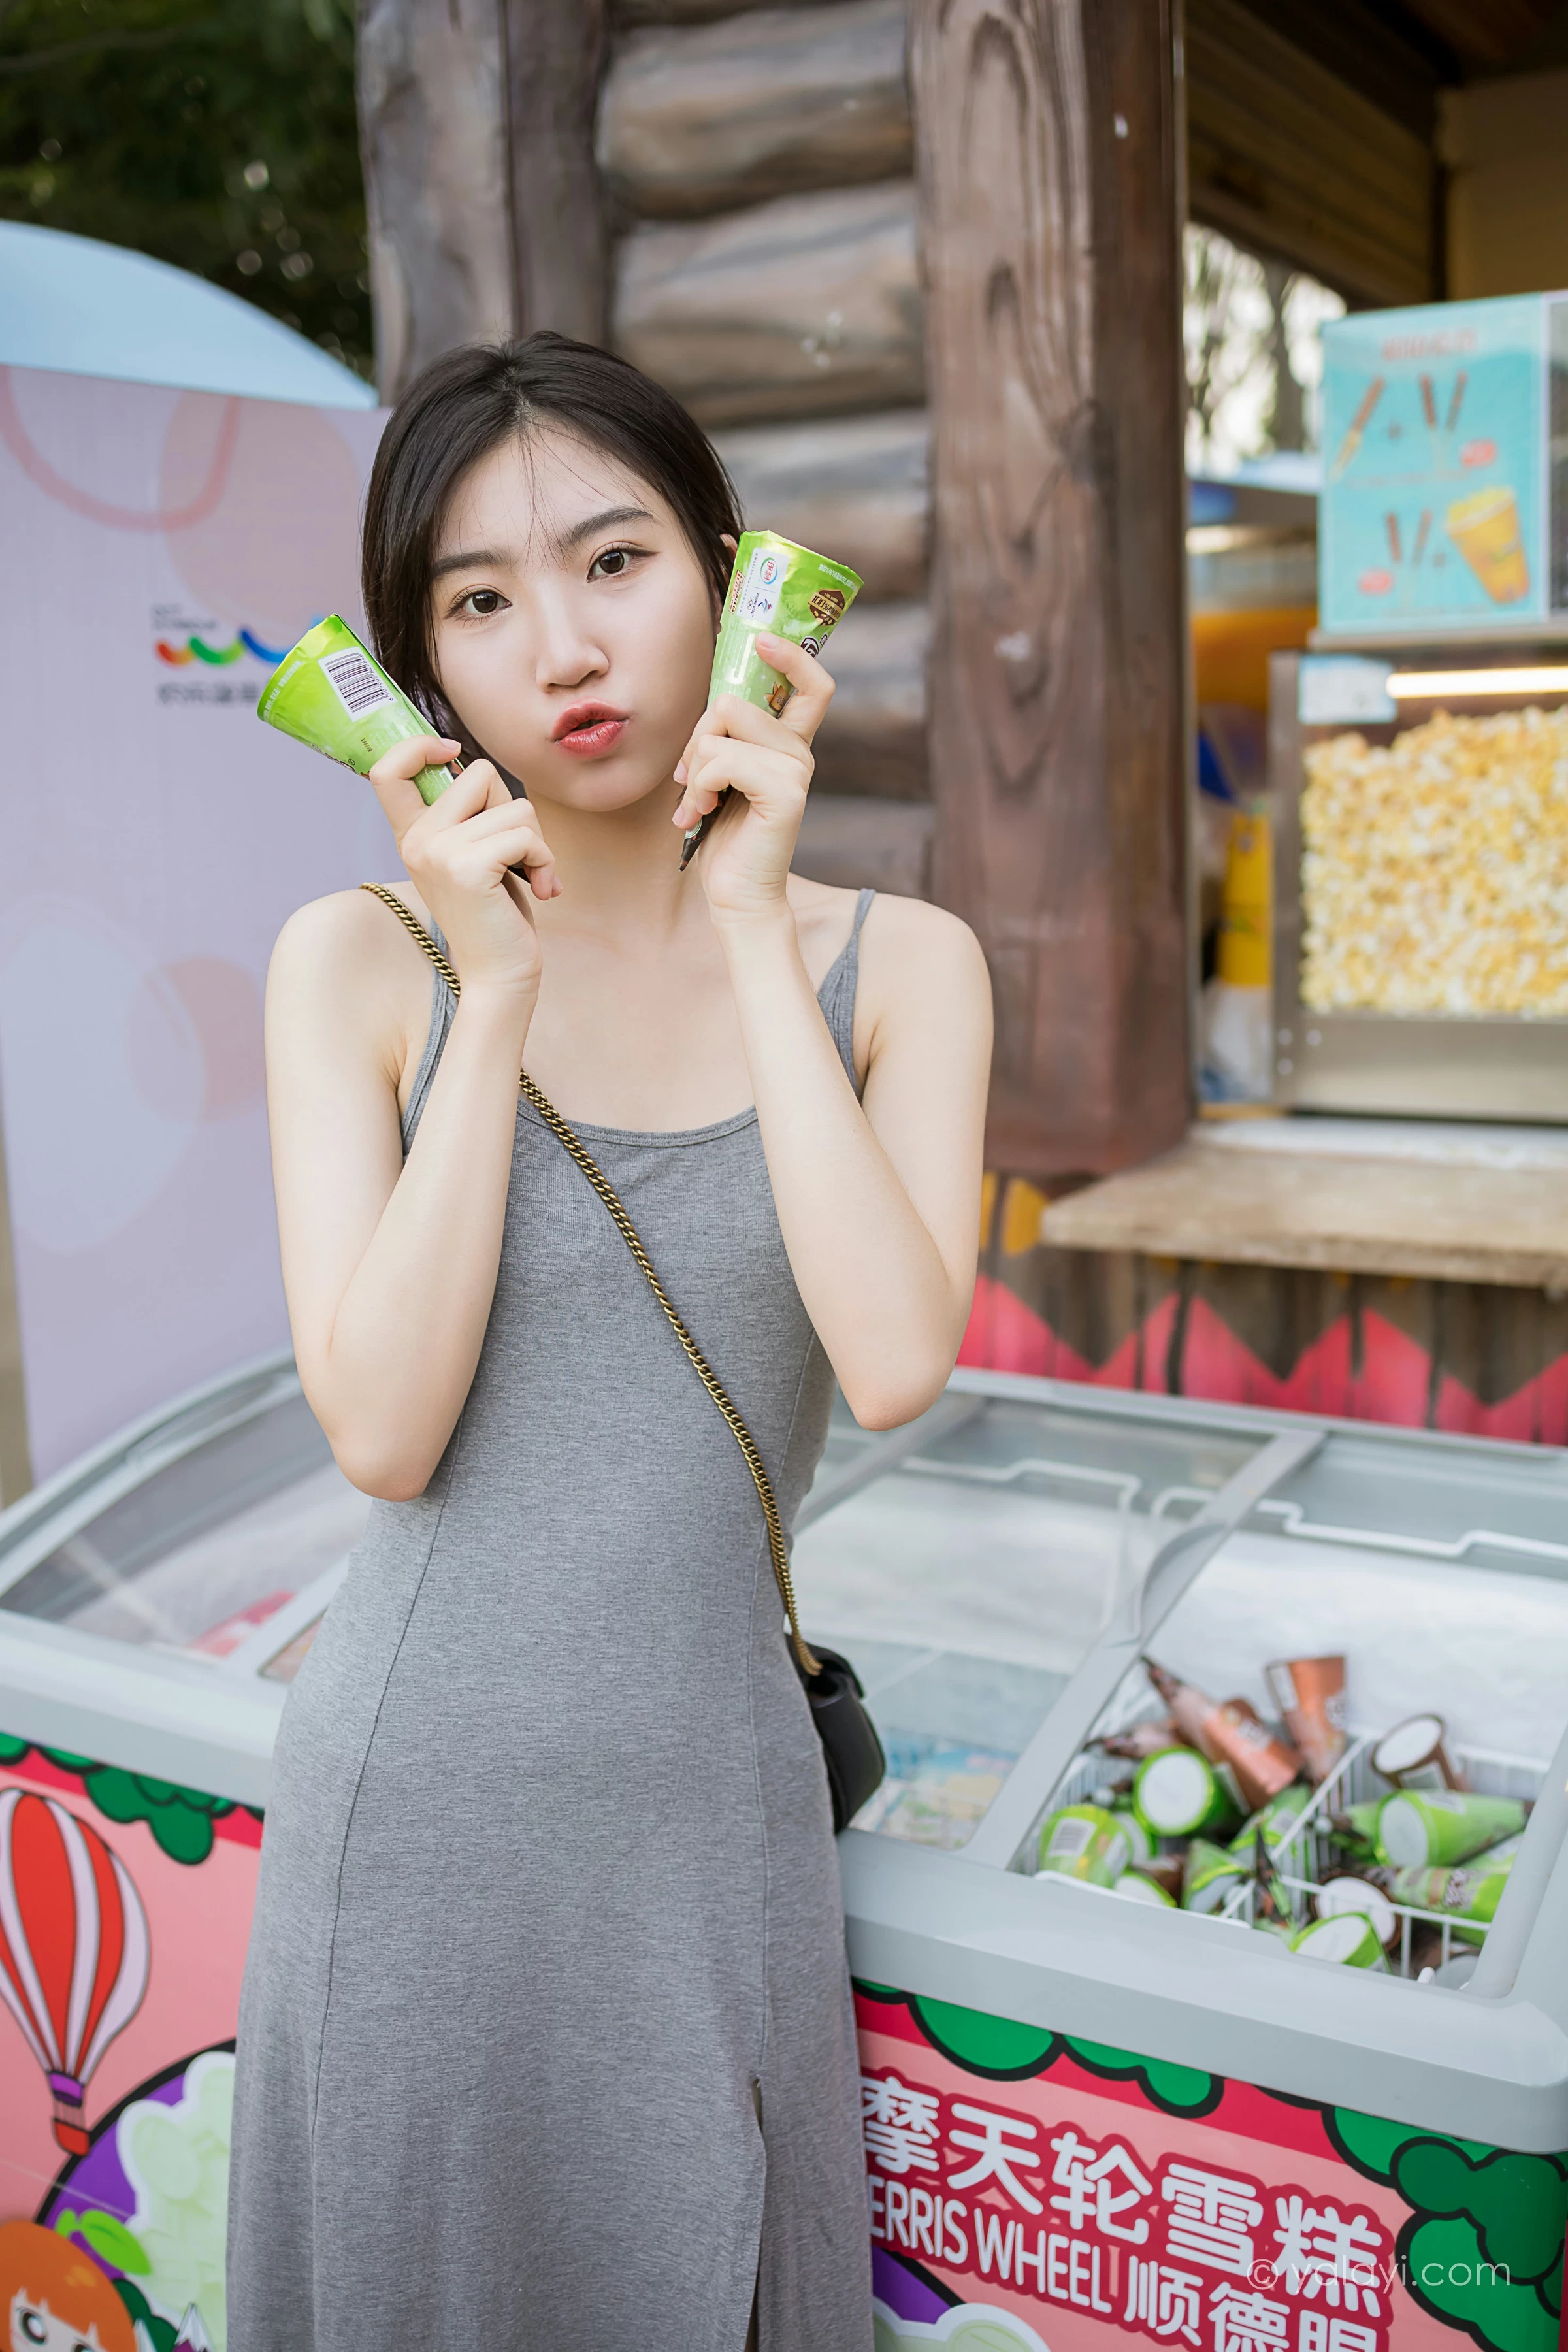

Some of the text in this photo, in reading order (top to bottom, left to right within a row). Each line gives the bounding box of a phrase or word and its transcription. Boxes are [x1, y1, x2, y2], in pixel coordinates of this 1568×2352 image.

[764, 561, 774, 581] 伊利
[861, 2076, 1383, 2317] 摩天轮雪糕
[868, 2174, 968, 2264] ERRIS
[974, 2207, 1112, 2313] WHEEL
